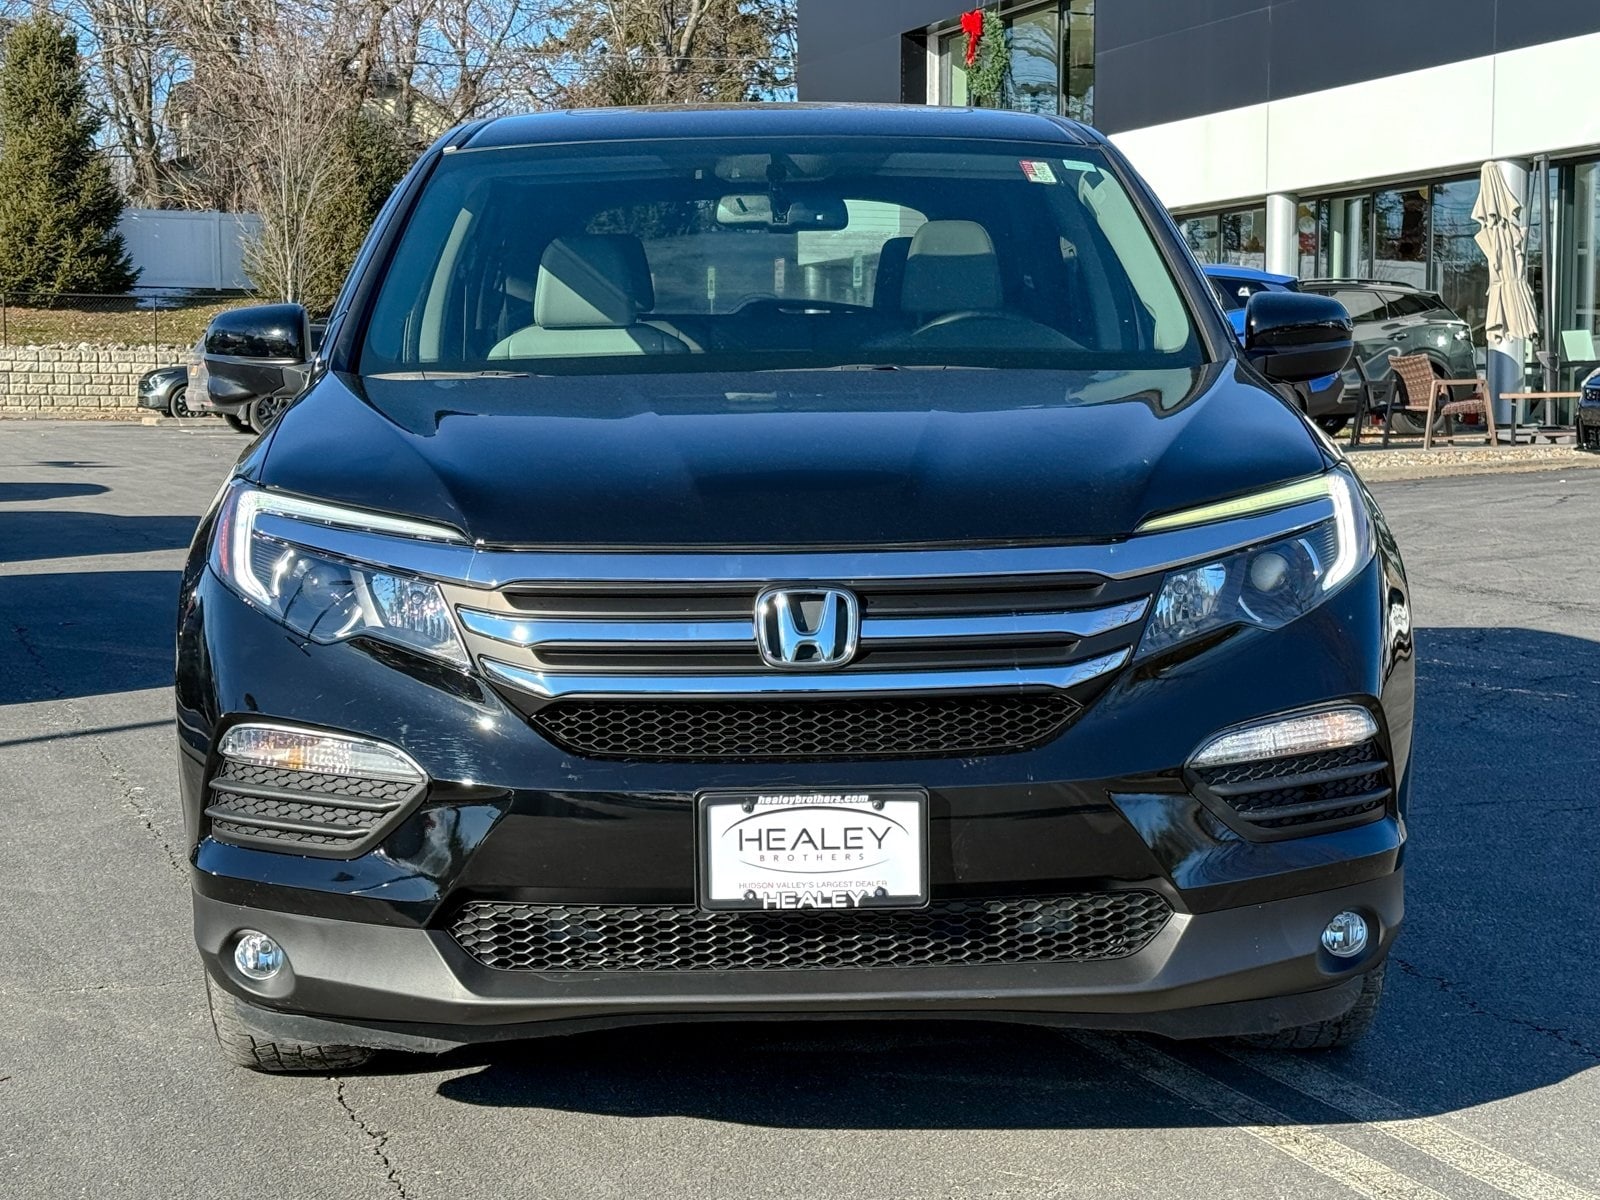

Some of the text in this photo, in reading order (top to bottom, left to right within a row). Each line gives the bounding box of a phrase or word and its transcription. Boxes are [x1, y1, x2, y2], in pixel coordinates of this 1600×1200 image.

[757, 795, 869, 805] healeybrothers.com
[738, 827, 892, 851] HEALEY
[760, 853, 864, 862] BROTHERS
[776, 881, 815, 889] VALLEY'S
[855, 880, 888, 888] DEALER
[763, 890, 865, 909] HEALEY
